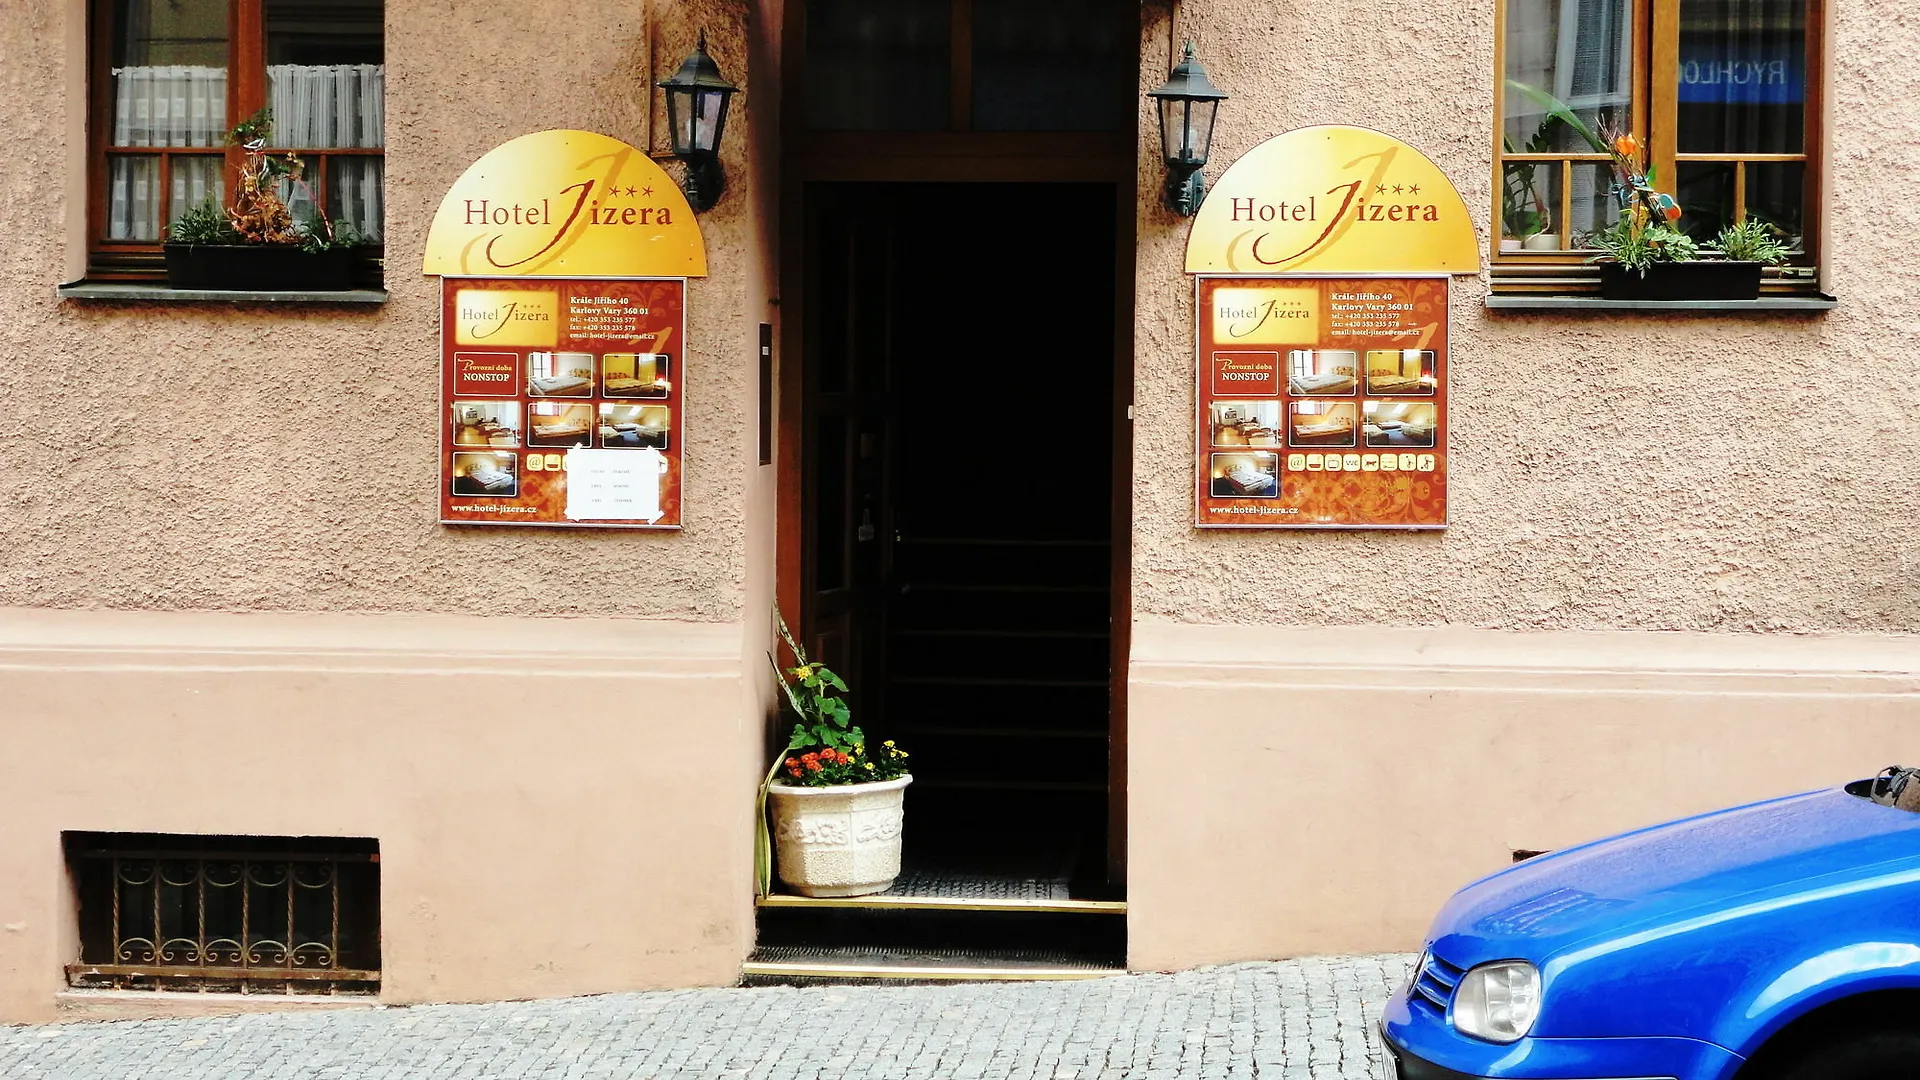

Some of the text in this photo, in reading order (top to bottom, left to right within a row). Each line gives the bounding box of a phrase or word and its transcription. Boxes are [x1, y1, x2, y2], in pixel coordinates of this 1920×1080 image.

[463, 179, 673, 268] Hotel Jizera
[1230, 180, 1439, 265] Hotel Jizera
[619, 297, 629, 305] 40
[570, 306, 649, 316] Karlovy Vary 360 01
[1331, 303, 1413, 312] Karlovy Vary 360 01
[462, 302, 549, 339] Hotel Jizera
[1220, 300, 1310, 338] Hotel Jizera
[463, 373, 510, 381] NONSTOP
[1222, 372, 1270, 381] NONSTOP
[451, 504, 537, 514] www.hotel-jizera.cz
[1209, 505, 1299, 516] www.hotel-jizera.cz
